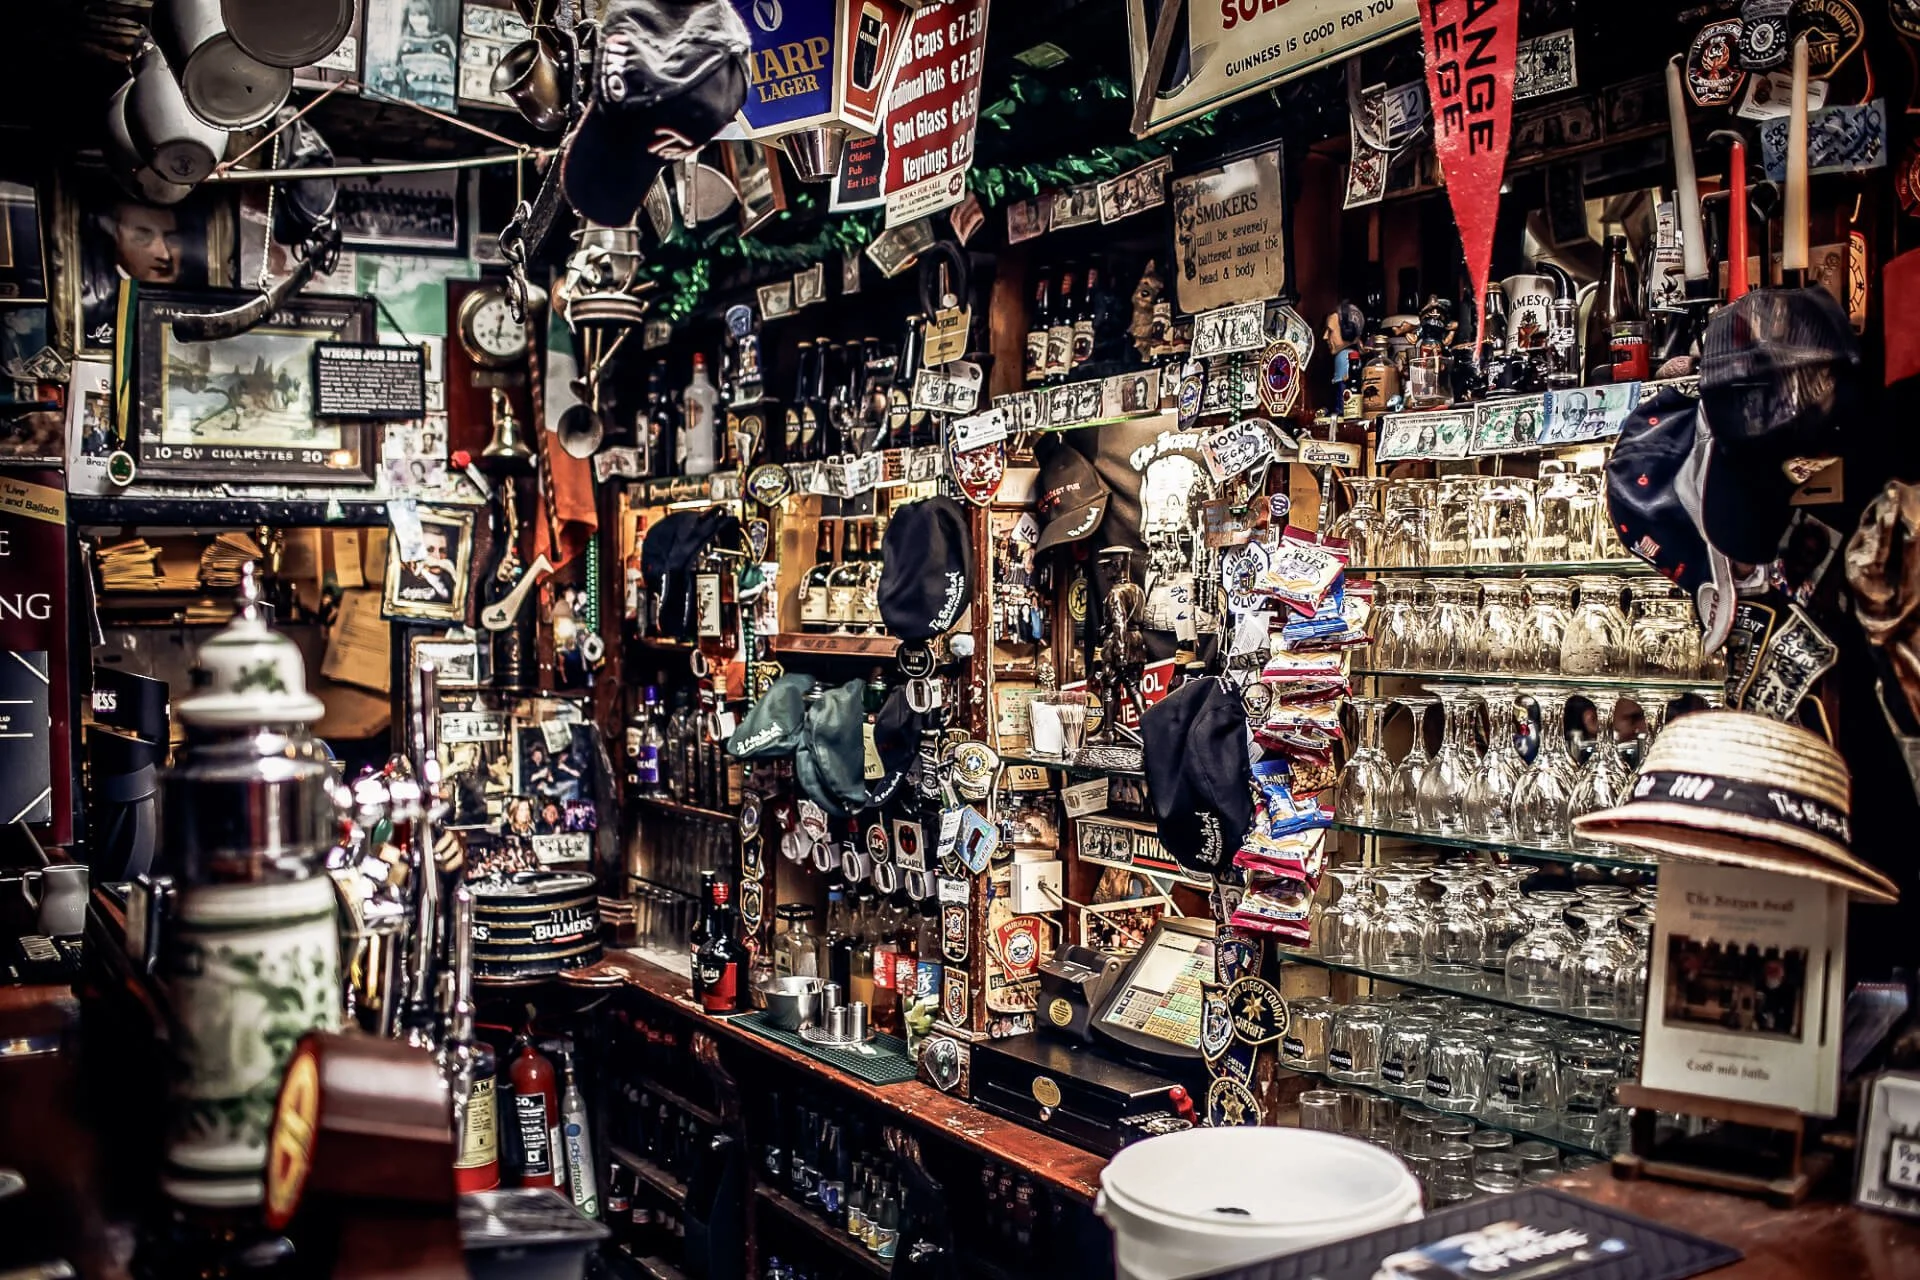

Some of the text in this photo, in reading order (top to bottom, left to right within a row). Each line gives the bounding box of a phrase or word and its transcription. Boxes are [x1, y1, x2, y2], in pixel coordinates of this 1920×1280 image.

[1826, 1, 1857, 39] COUNTY
[914, 27, 944, 60] Caps
[1226, 0, 1394, 77] GUINNESS IS GOOD FOR YOU
[757, 73, 820, 103] LAGER
[925, 66, 945, 95] Hats
[893, 117, 914, 149] Shot
[916, 107, 948, 138] Glass
[848, 151, 871, 162] Oldest
[903, 147, 948, 184] Keyrings
[848, 165, 863, 176] Pub
[847, 179, 859, 189] Est
[929, 179, 941, 191] SALE
[1196, 192, 1258, 225] SMOKERS
[1196, 218, 1268, 247] will be severely
[1197, 235, 1279, 267] battered about the
[1198, 271, 1218, 286] head
[1222, 266, 1229, 280] &
[1235, 262, 1256, 278] body
[320, 347, 419, 362] WHOSE JOB IS IT?
[211, 449, 294, 462] CIGARETTES
[302, 451, 323, 463] 20
[6, 498, 60, 517] and Ballads
[1021, 524, 1037, 541] JK
[1226, 547, 1265, 577] CHICAGO
[1229, 589, 1261, 609] POLIC
[1018, 768, 1039, 780] JOB
[897, 856, 924, 868] BACARDI
[533, 916, 593, 940] BULMERS
[1004, 920, 1034, 933] DURHAM
[1015, 968, 1031, 976] FIRE
[1229, 980, 1285, 1030] SAN DIEGO COUNTY
[1234, 1015, 1266, 1039] SHERIFF
[1231, 1083, 1257, 1113] COUNTY
